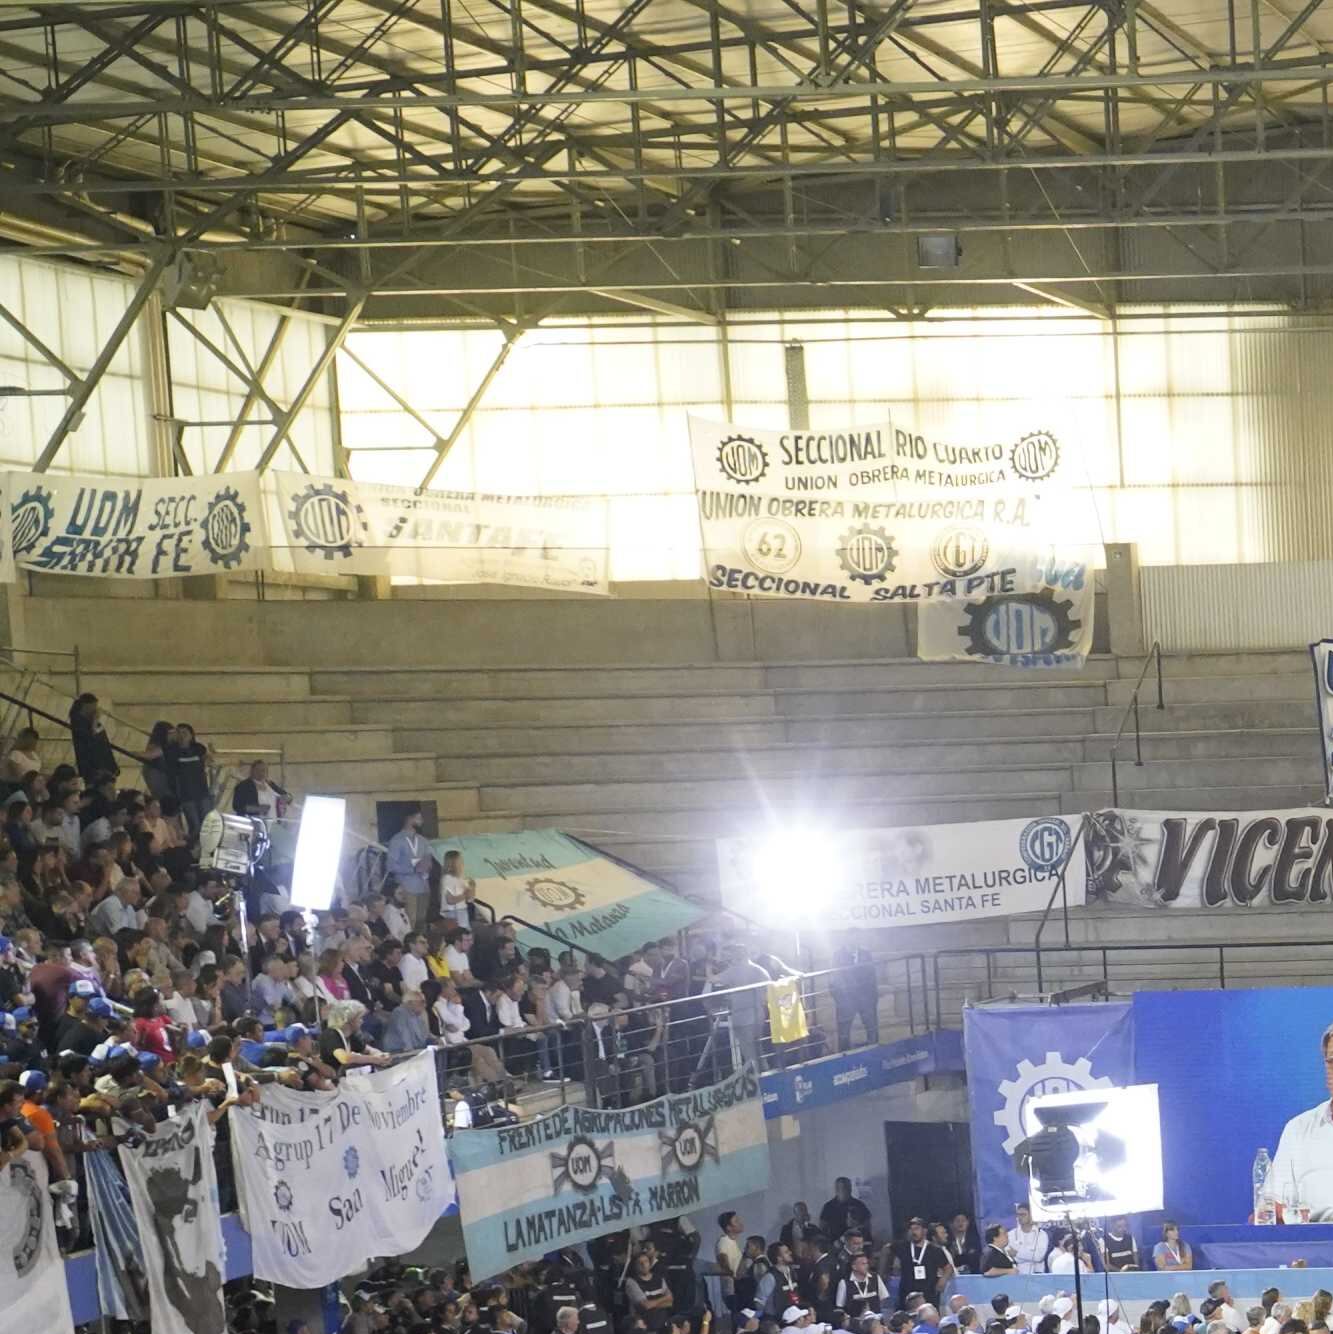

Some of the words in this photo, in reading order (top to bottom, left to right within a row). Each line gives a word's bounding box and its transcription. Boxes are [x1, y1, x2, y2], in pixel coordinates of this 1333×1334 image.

[779, 430, 887, 466] SECCIONAL
[895, 428, 928, 460] RIO
[933, 442, 1004, 466] CUARTO
[784, 475, 839, 492] UNION
[849, 466, 910, 488] OBRERA
[914, 469, 1007, 489] METALURGICA
[67, 487, 142, 537] UOM
[701, 489, 762, 521] UNION
[767, 497, 845, 520] OBRERA
[851, 500, 986, 522] METALURGICA
[151, 528, 194, 574] FE
[757, 529, 788, 558] 62
[709, 564, 851, 599] SECCIONAL
[870, 580, 959, 601] SALTA
[964, 568, 1017, 595] PTE
[915, 867, 1061, 899] METALURGICA
[919, 895, 974, 917] SANTA
[976, 892, 1001, 909] FE
[254, 1130, 314, 1172] Agrup
[336, 1100, 362, 1134] De
[498, 1122, 552, 1155] FRENTE
[679, 1137, 698, 1157] UOM
[328, 1187, 365, 1230] San
[379, 1127, 427, 1202] Miguel
[571, 1157, 592, 1175] UOM
[503, 1218, 526, 1253] LA
[648, 1176, 701, 1213] MARRON
[270, 1219, 313, 1258] UOM
